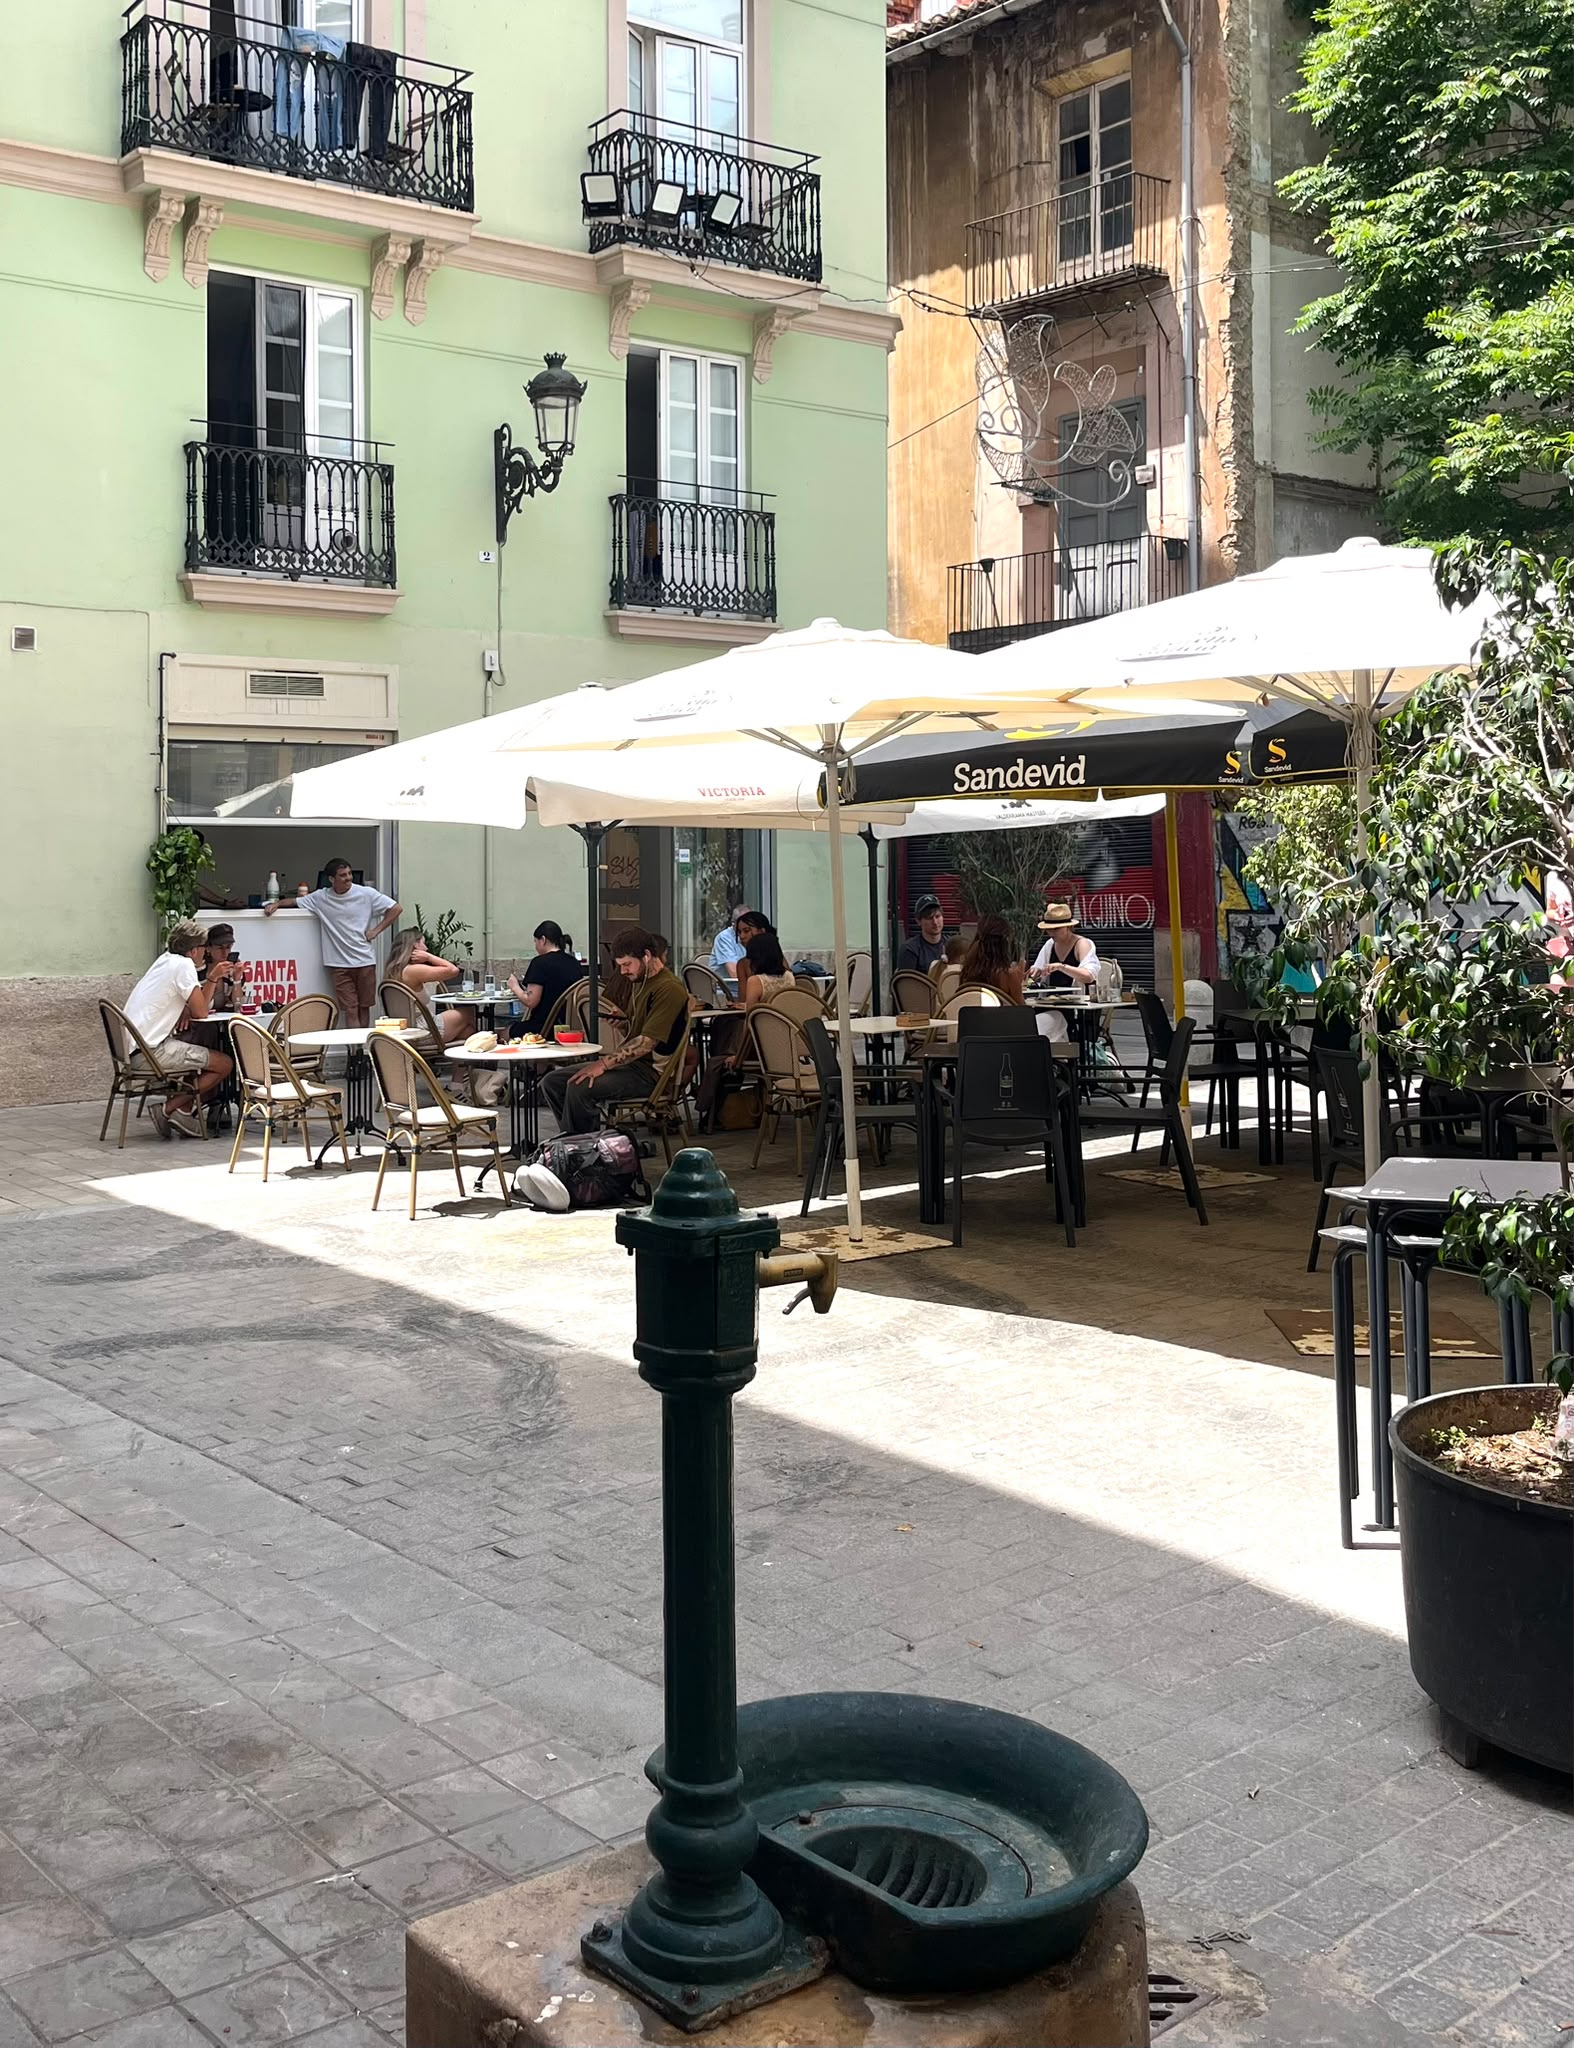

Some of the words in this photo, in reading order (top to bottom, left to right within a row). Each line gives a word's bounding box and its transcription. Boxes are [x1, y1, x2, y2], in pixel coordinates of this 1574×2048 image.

[483, 551, 491, 561] 2
[953, 754, 1087, 792] Sandevid
[1264, 764, 1292, 773] Sandevid
[1218, 776, 1244, 784] Sandevid
[698, 786, 766, 797] VICTORIA
[244, 959, 298, 982] SANTA
[253, 983, 297, 1006] INDA
